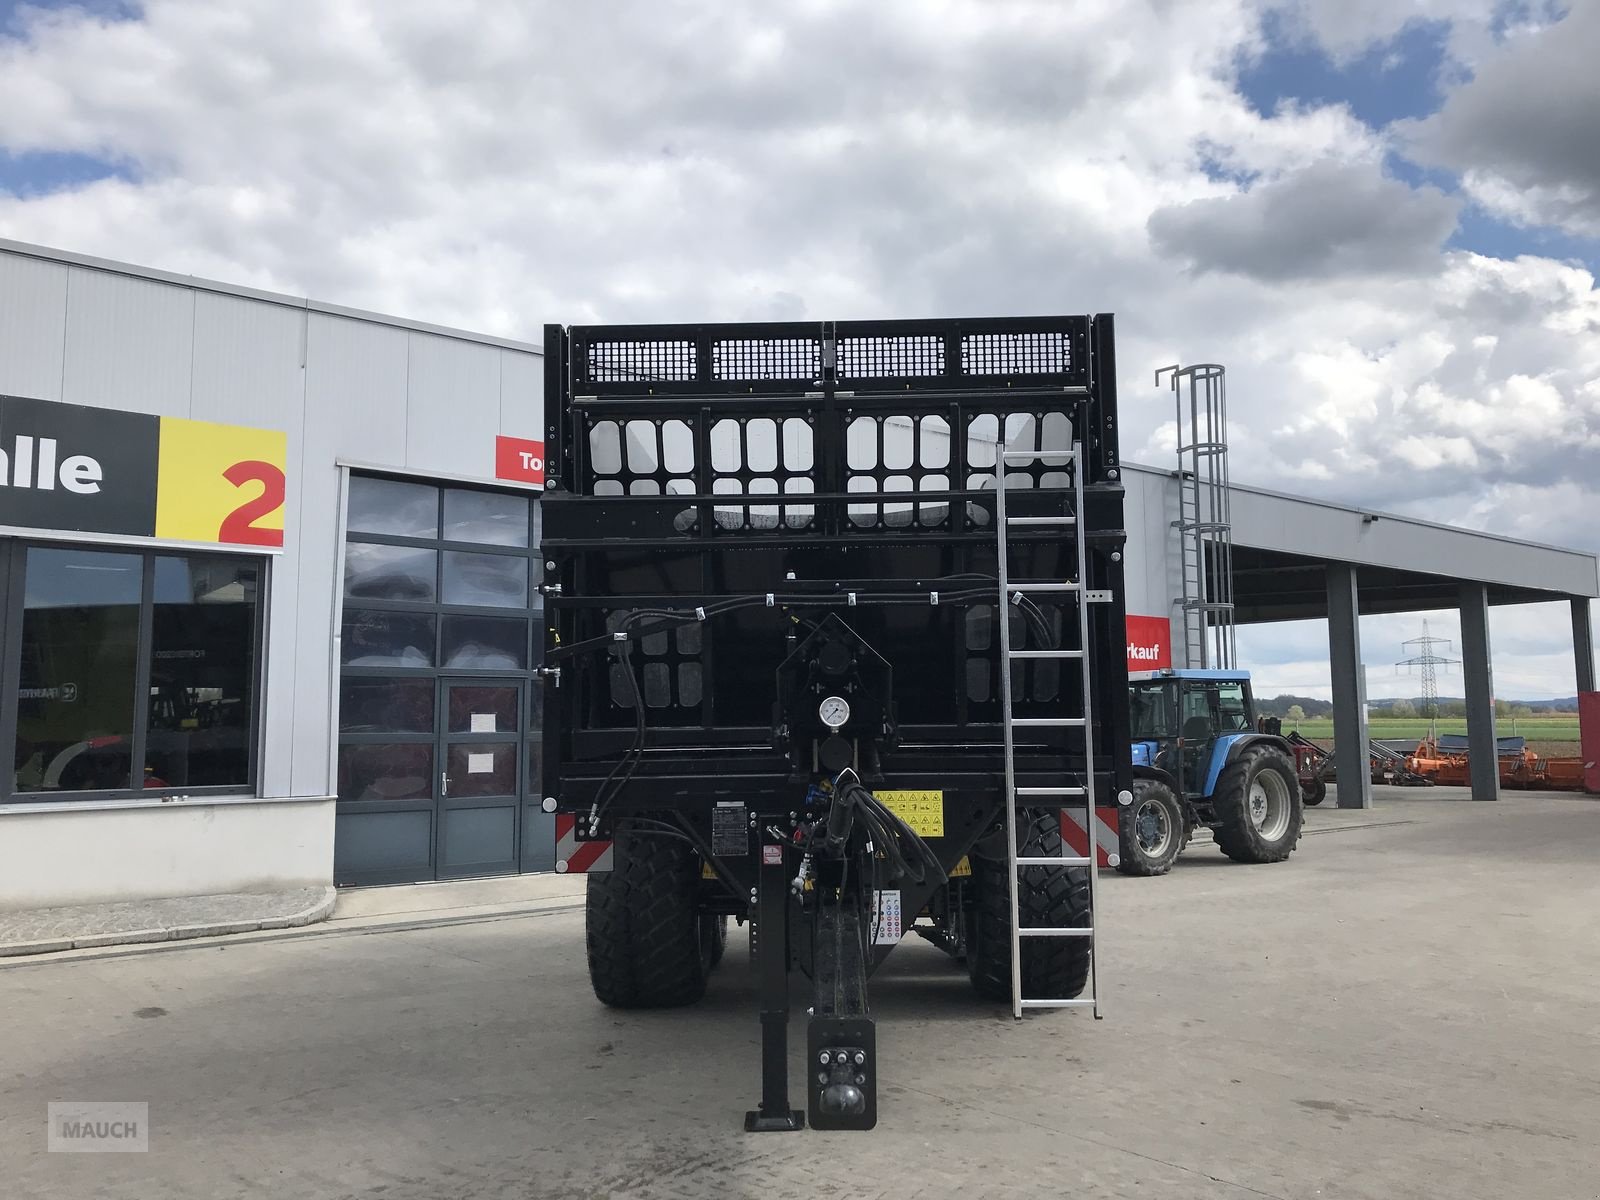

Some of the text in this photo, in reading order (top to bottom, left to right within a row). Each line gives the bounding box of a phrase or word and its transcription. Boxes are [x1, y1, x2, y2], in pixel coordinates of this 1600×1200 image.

[0, 434, 286, 547] lle 2
[519, 451, 544, 471] To
